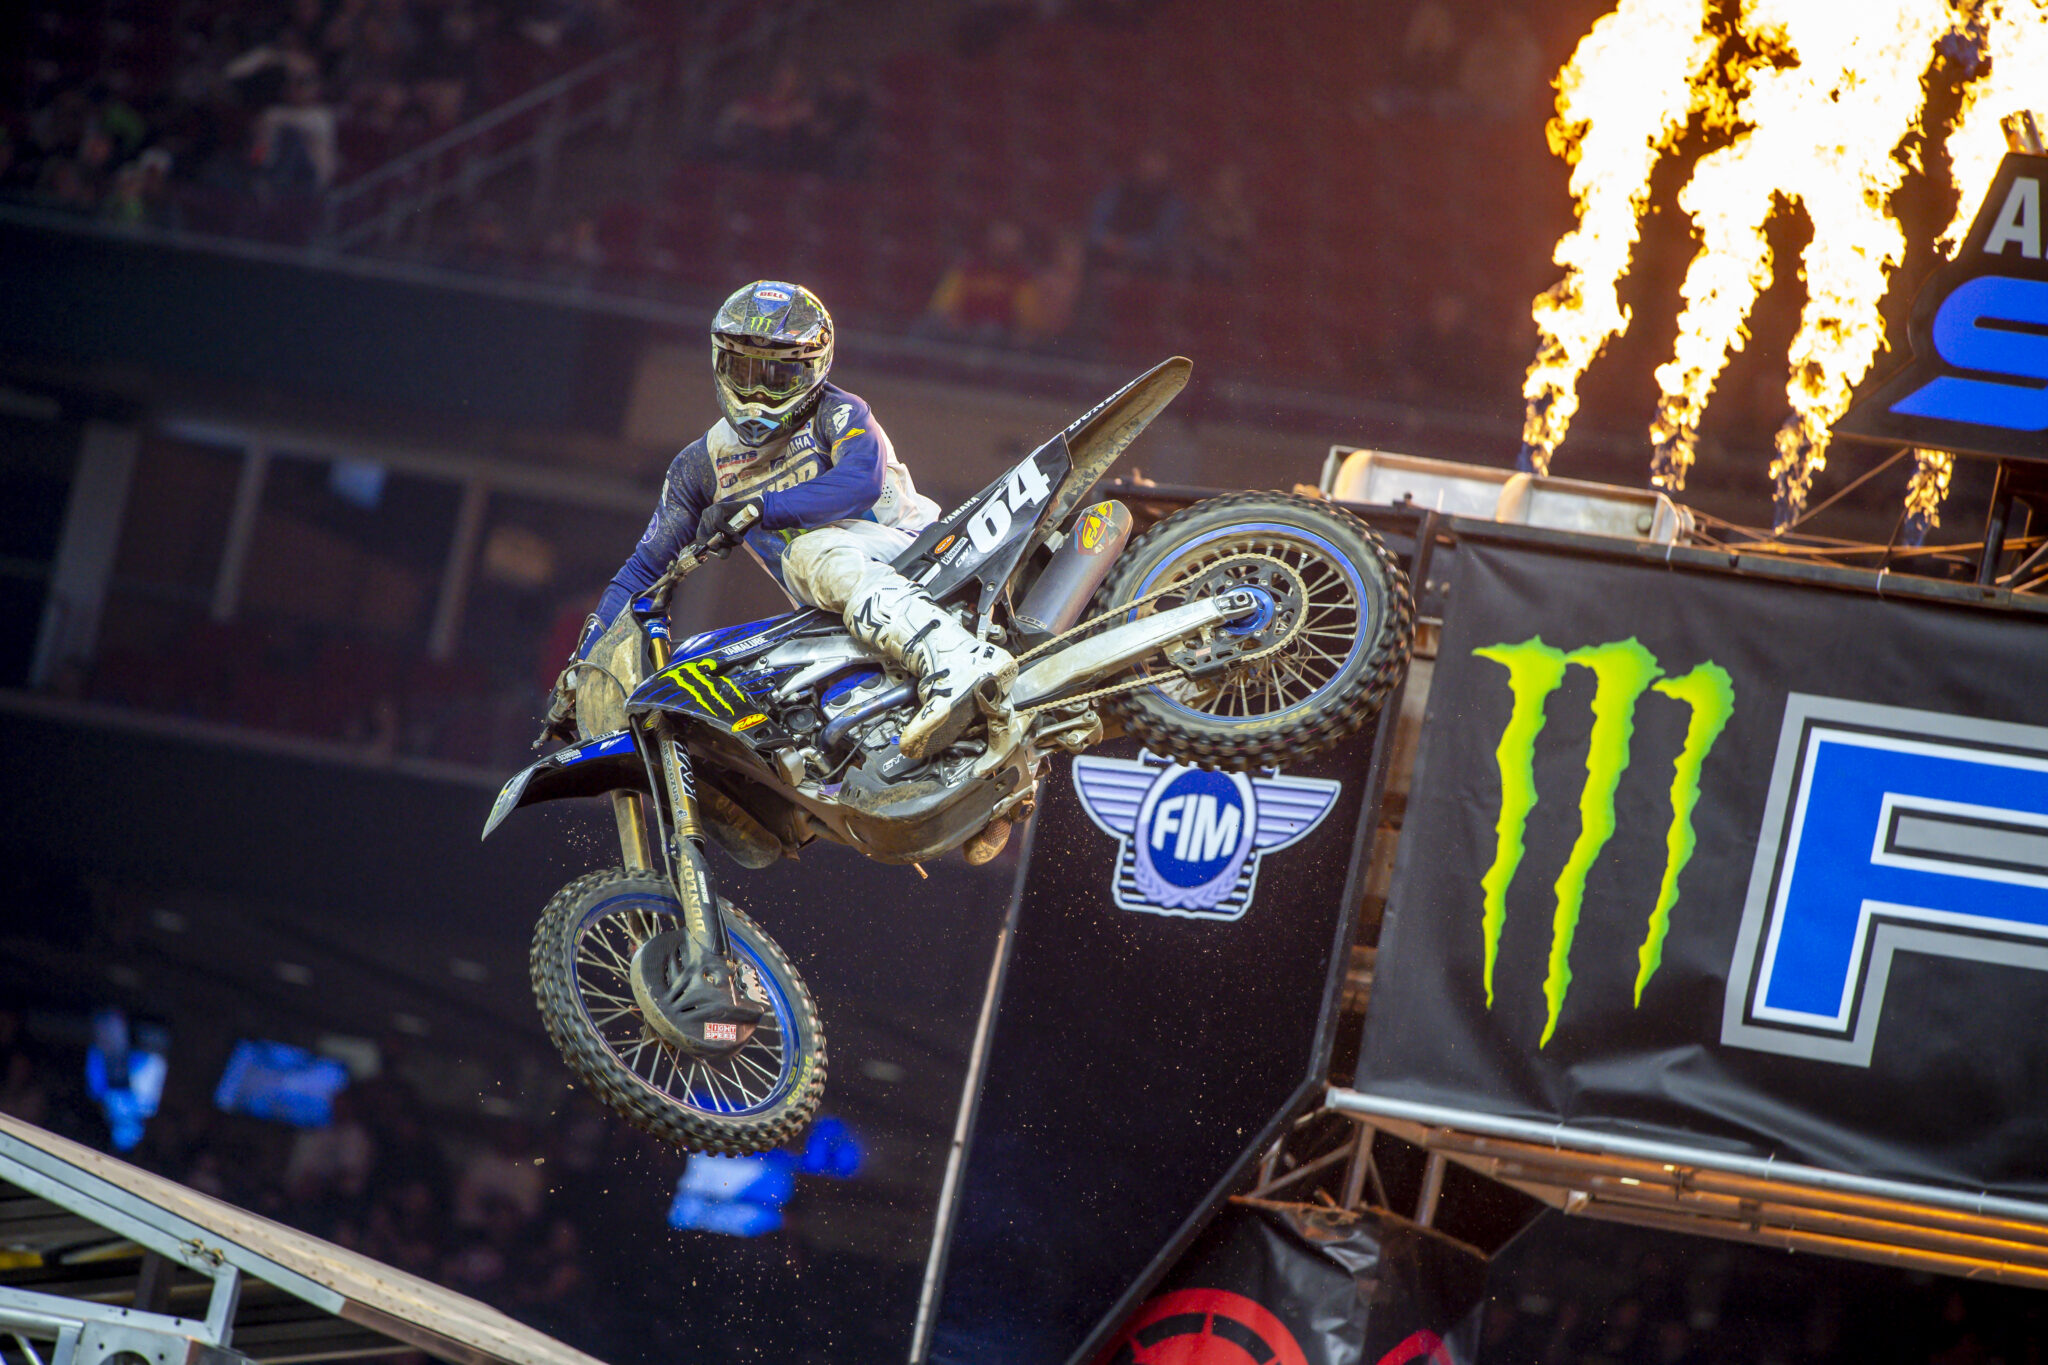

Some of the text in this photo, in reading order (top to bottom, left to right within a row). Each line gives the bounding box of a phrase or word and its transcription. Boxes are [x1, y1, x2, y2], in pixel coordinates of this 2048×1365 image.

[1984, 176, 2048, 260] A
[941, 496, 980, 525] YAMAHA
[966, 457, 1051, 554] 64
[722, 634, 769, 656] YAMALUBE
[1151, 793, 1242, 863] FIM
[682, 854, 707, 934] DUNLOP
[705, 1023, 737, 1033] LIGHT
[705, 1031, 737, 1041] SPEED
